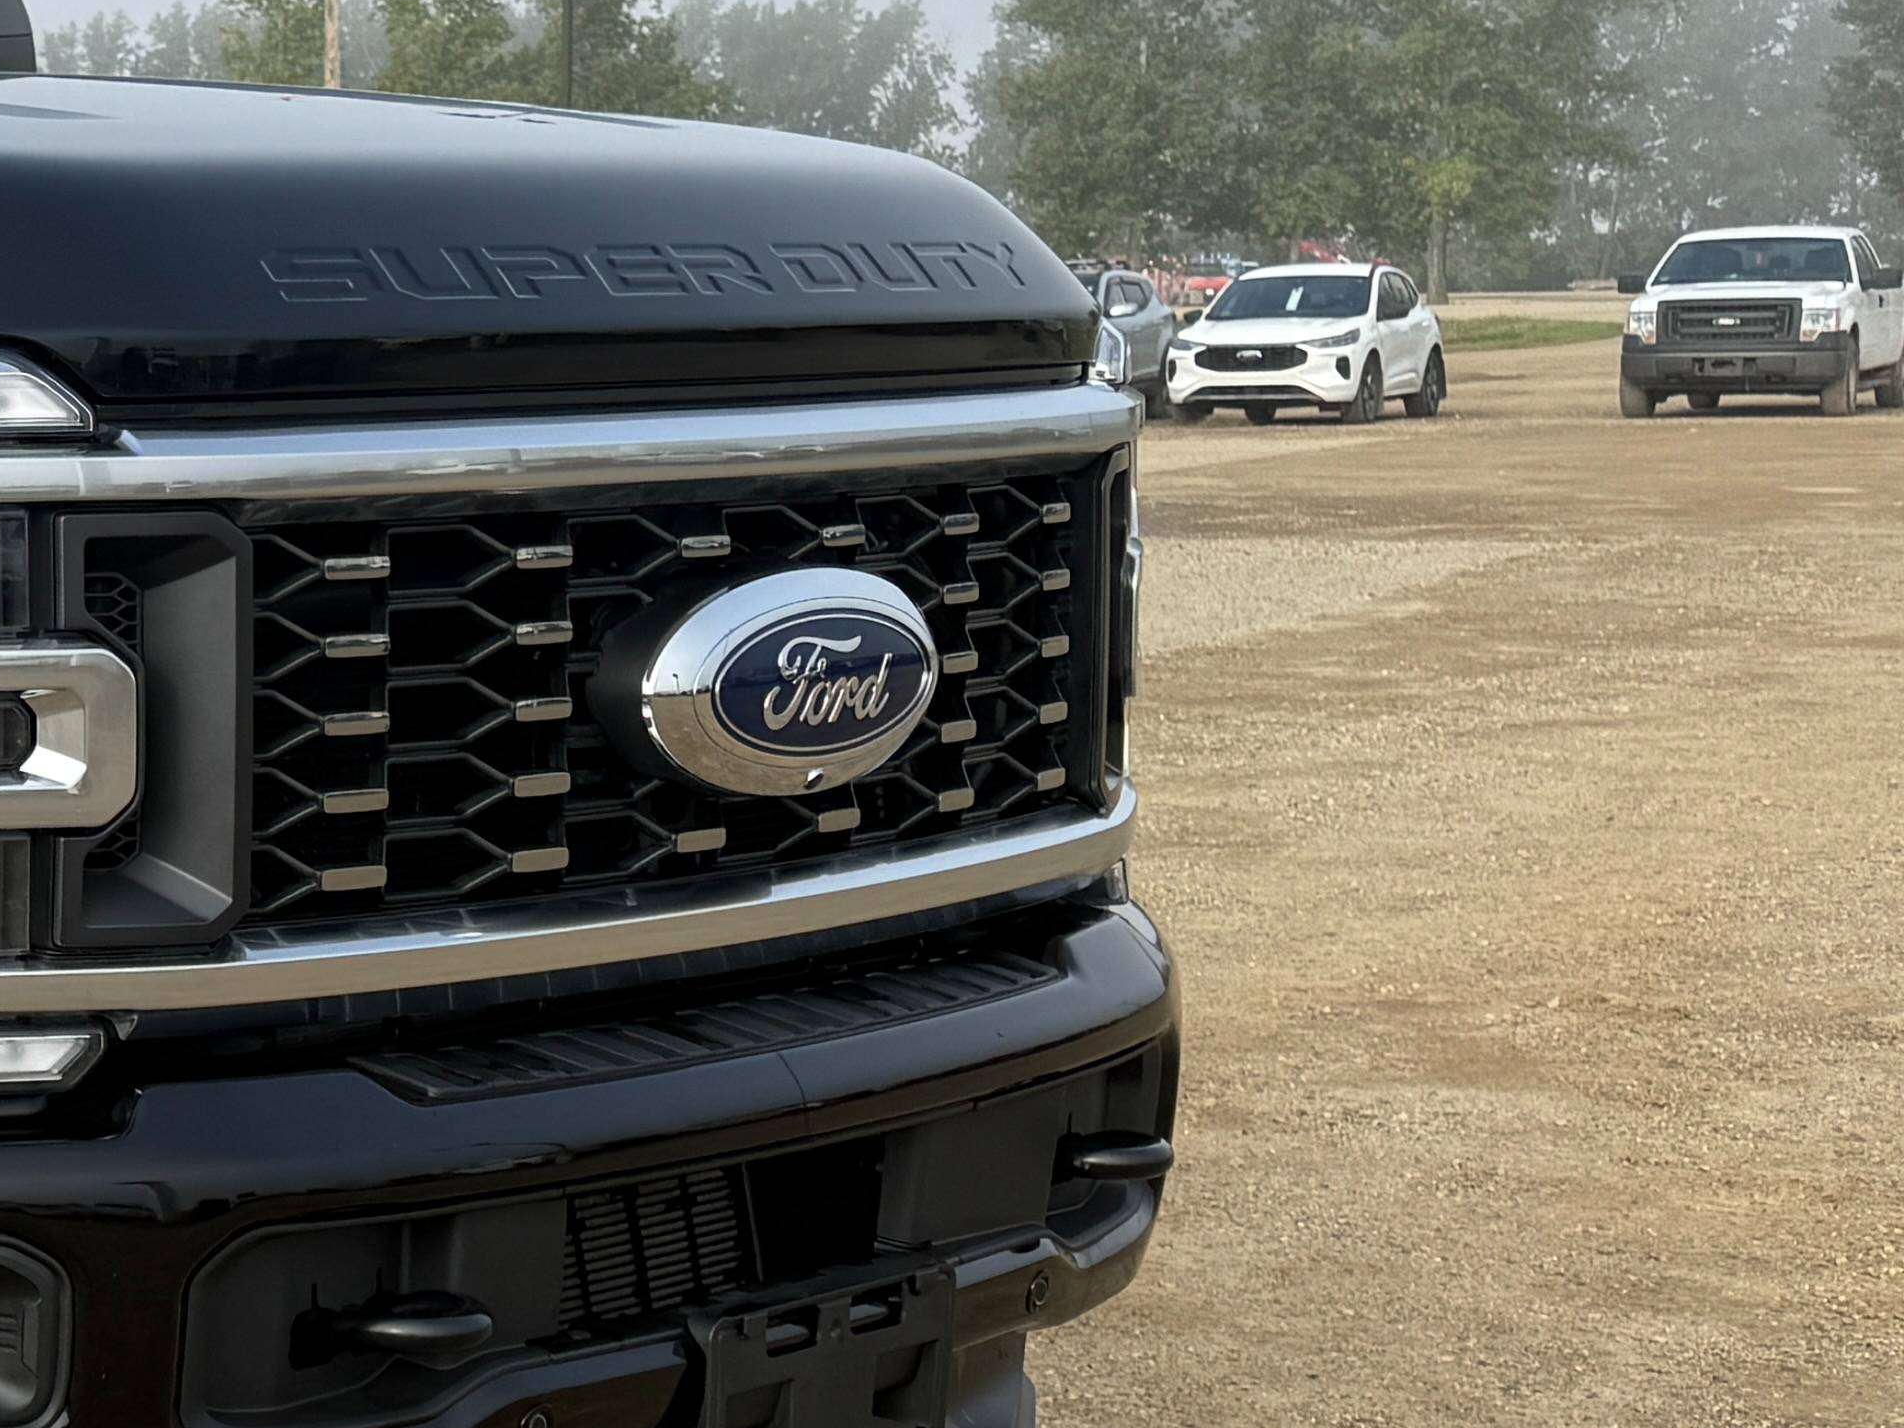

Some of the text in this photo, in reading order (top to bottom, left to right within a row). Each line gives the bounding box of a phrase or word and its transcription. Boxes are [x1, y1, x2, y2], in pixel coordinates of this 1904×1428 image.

[260, 242, 1026, 302] SUPER DUTY
[763, 635, 894, 731] Ford
